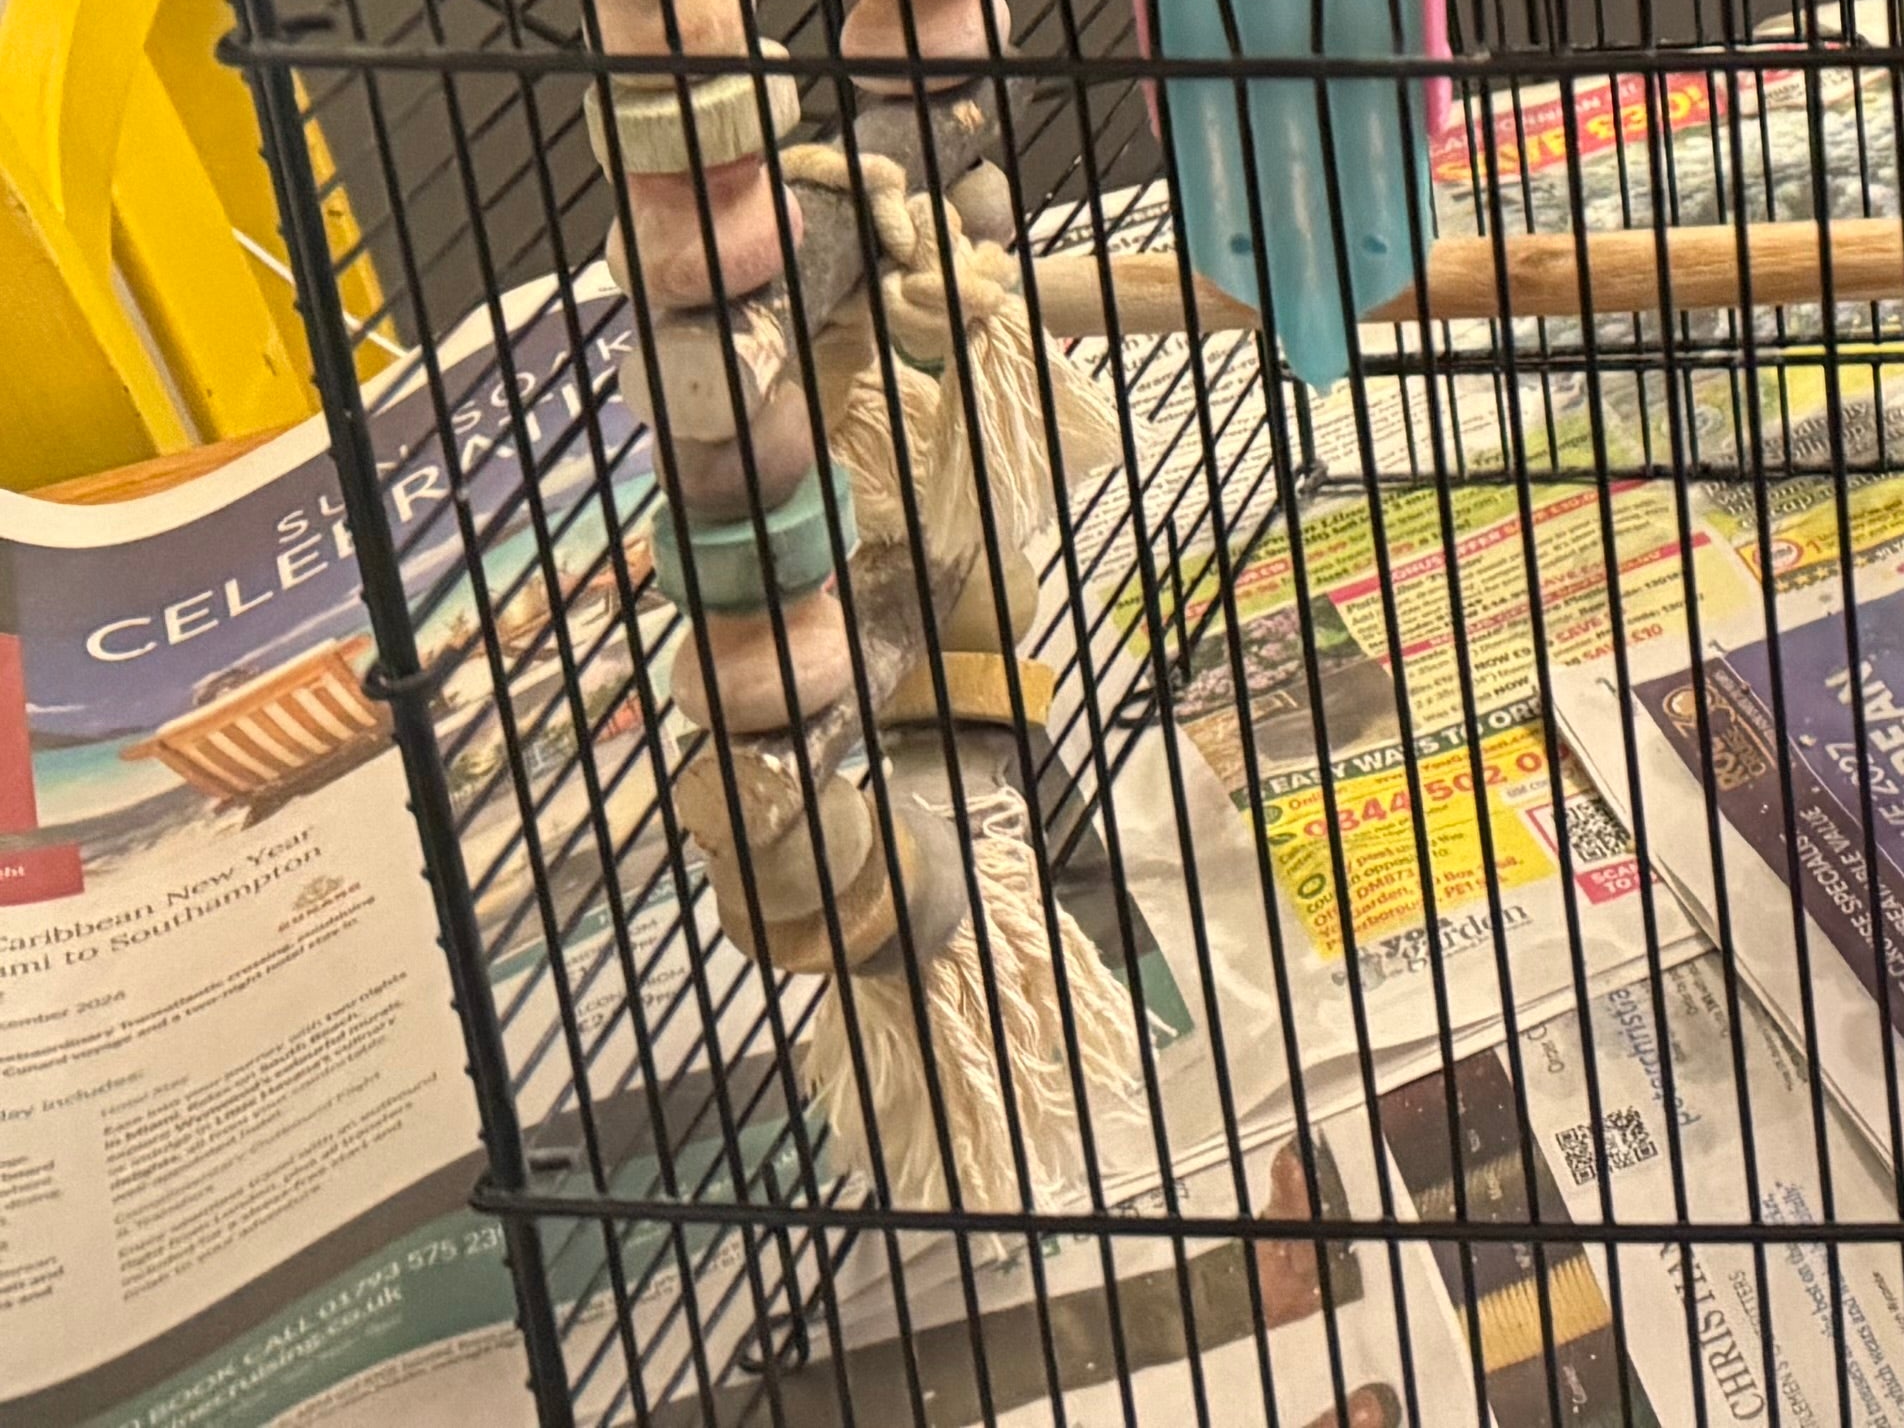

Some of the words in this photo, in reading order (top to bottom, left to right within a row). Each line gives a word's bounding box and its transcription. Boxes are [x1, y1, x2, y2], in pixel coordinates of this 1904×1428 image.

[64, 942, 99, 966] to
[110, 846, 323, 952] Southampton
[166, 867, 236, 906] New
[245, 824, 318, 867] Year
